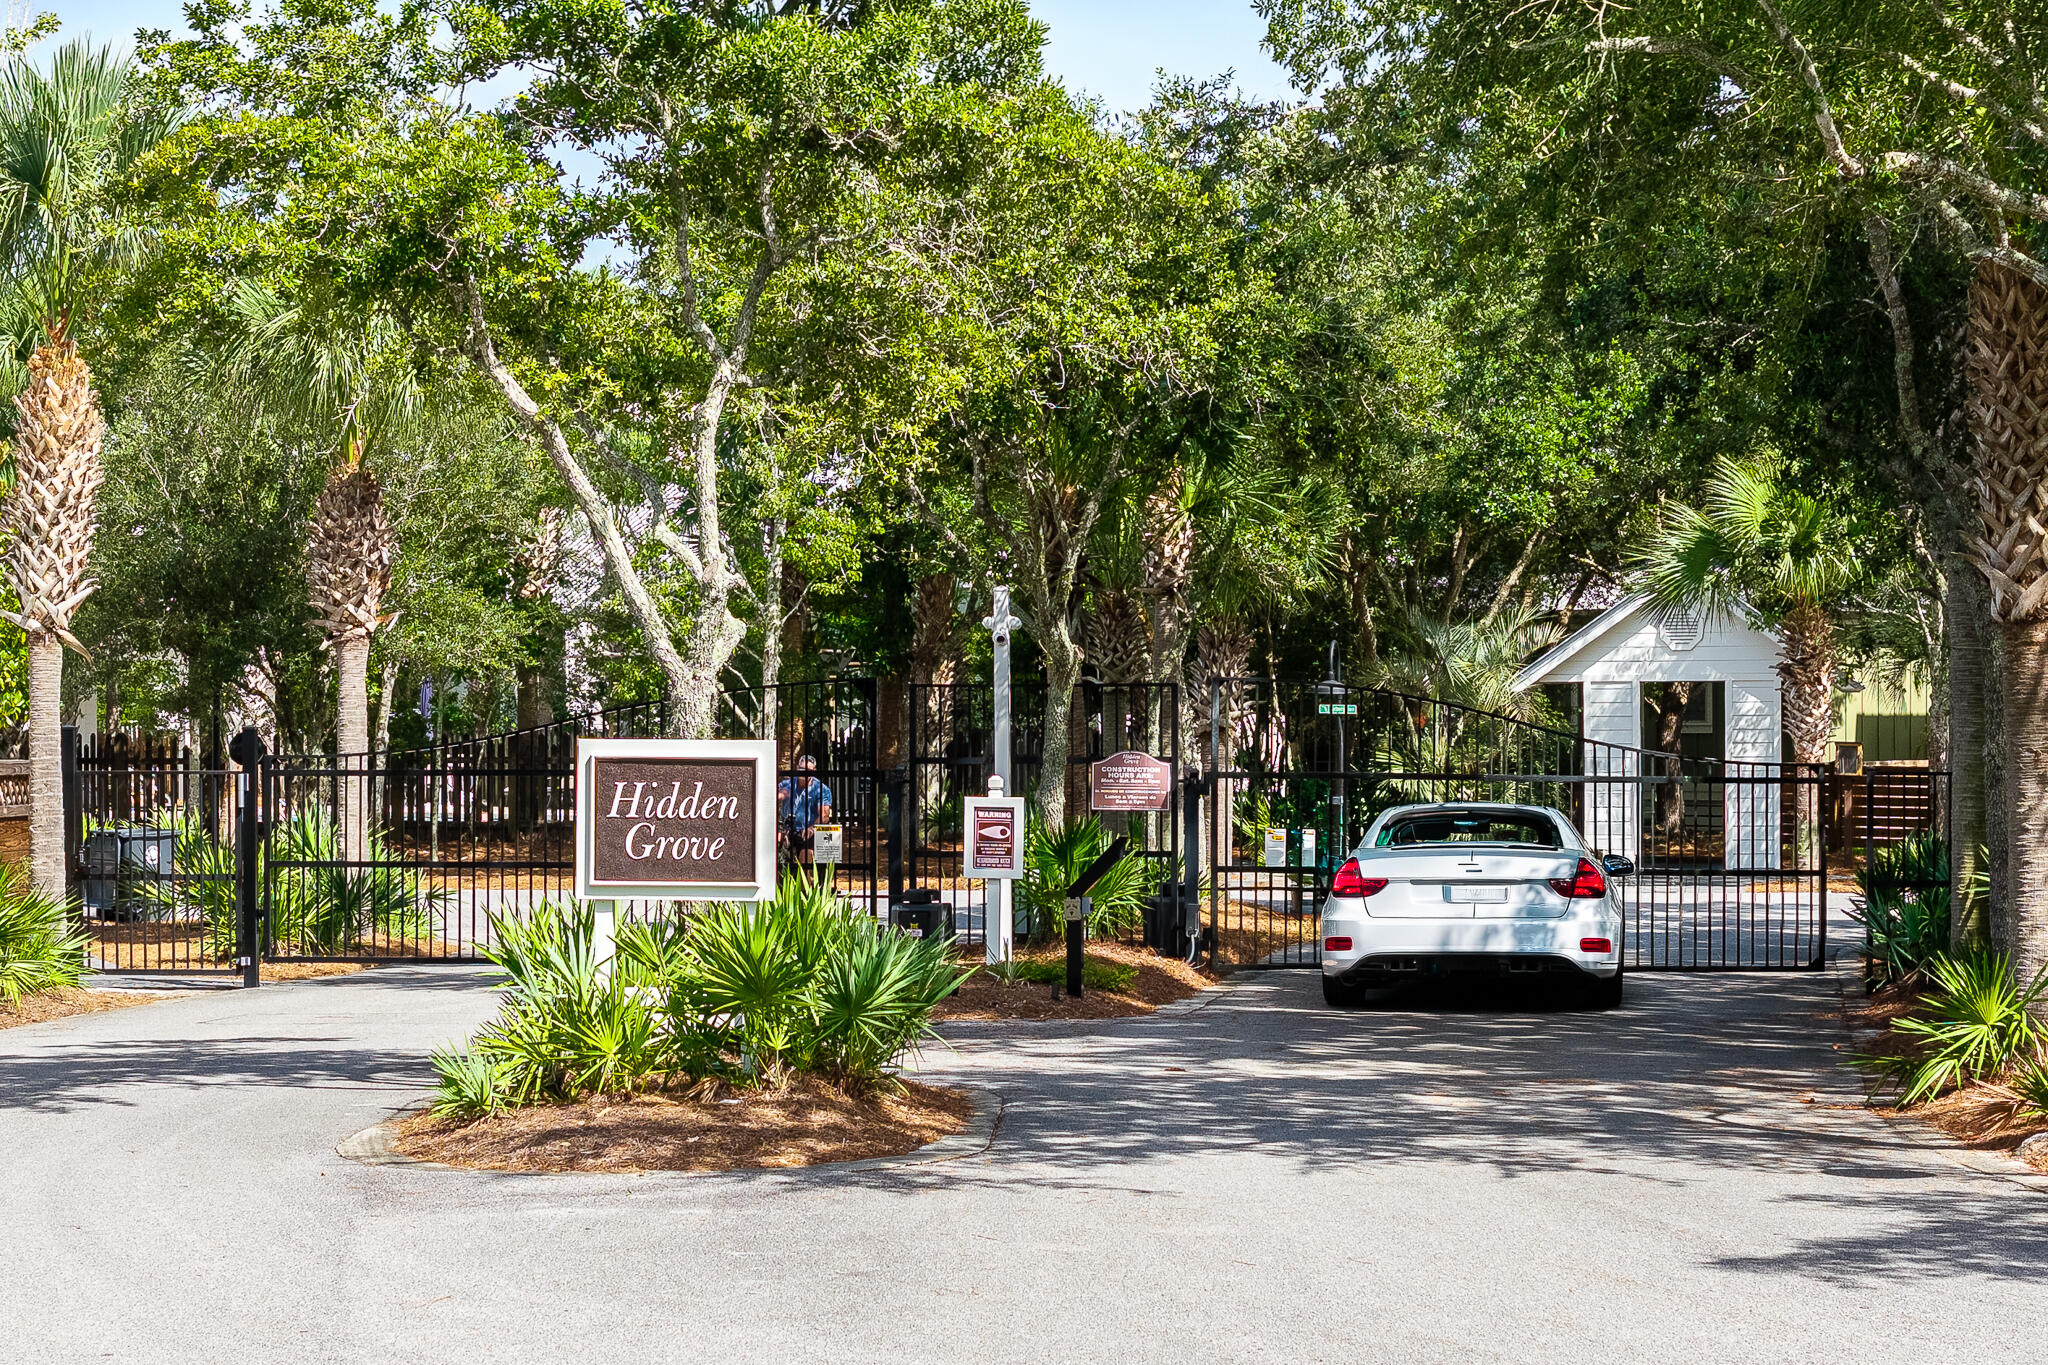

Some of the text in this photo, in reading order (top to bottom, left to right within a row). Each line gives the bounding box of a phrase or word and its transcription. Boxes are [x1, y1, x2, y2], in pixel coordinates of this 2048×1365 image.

[606, 781, 740, 819] Hidden
[977, 810, 1012, 818] WARNING
[624, 822, 726, 860] Grove
